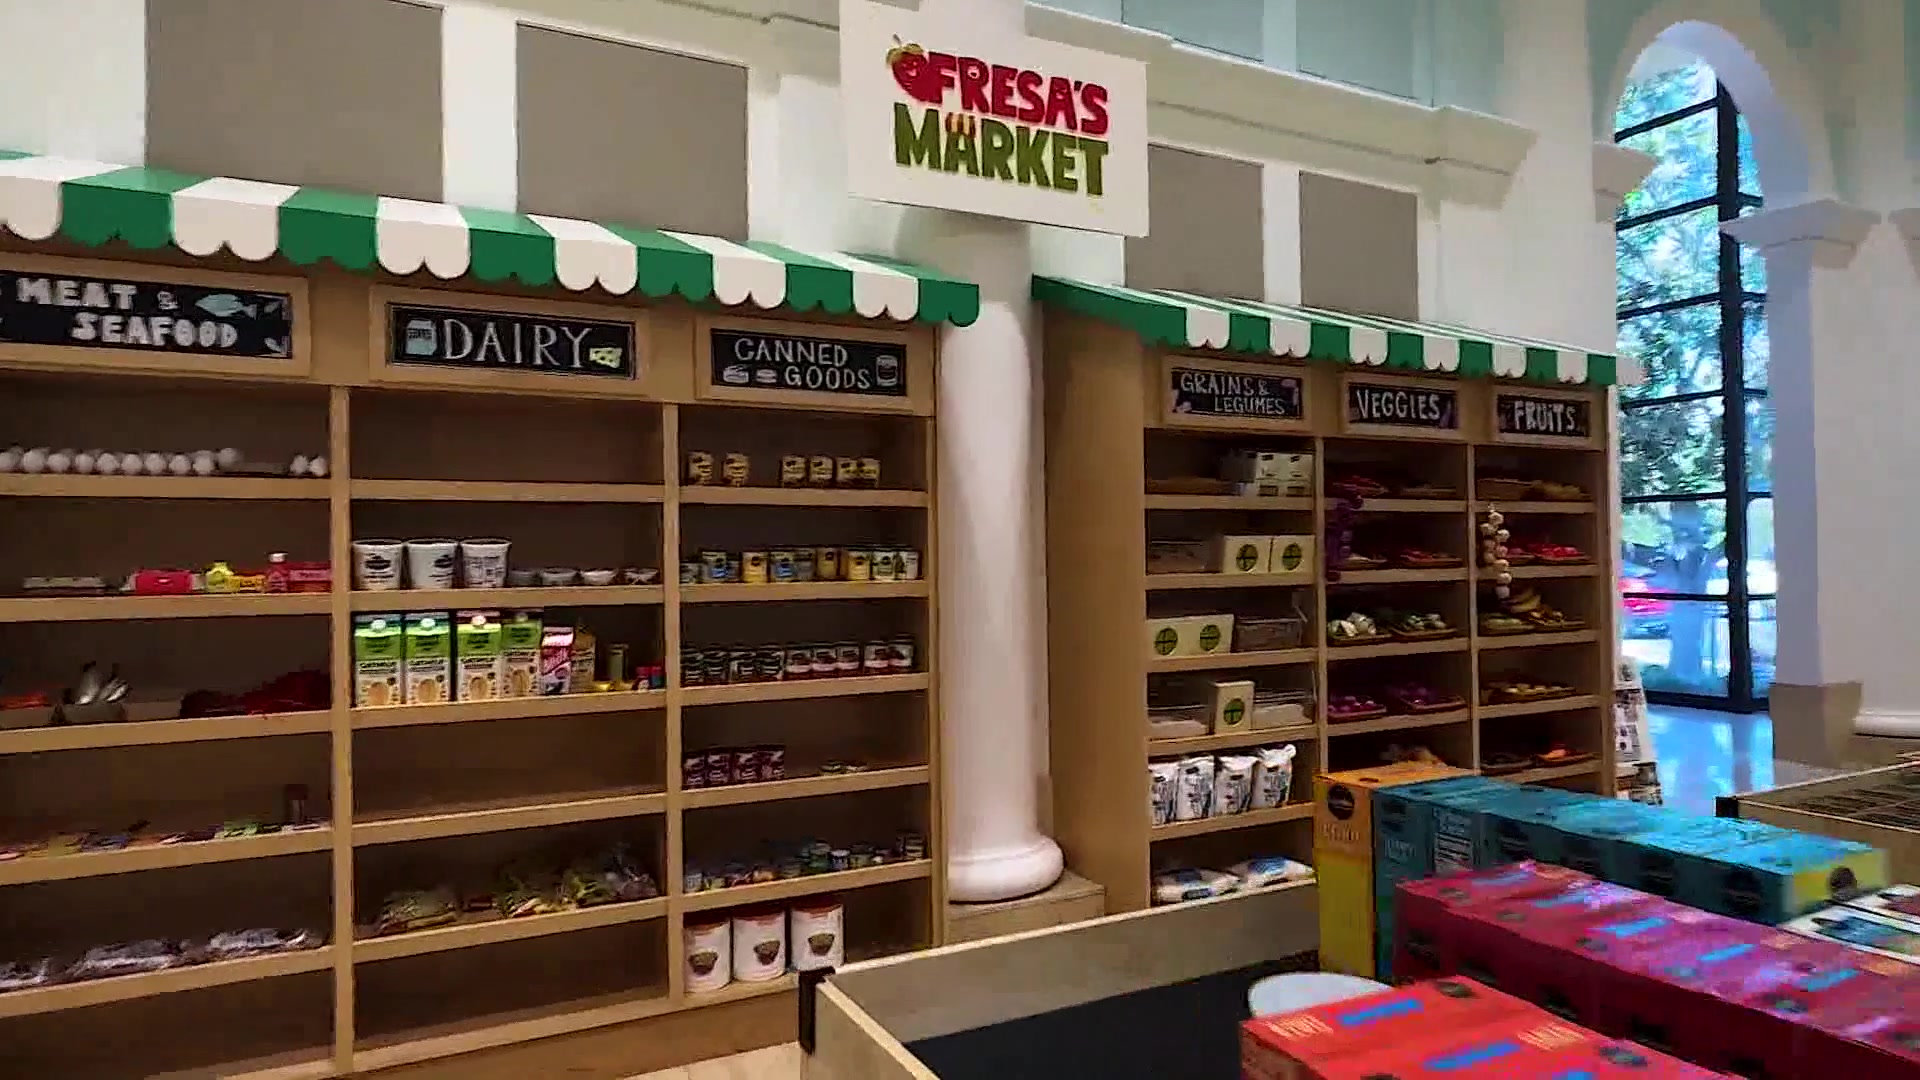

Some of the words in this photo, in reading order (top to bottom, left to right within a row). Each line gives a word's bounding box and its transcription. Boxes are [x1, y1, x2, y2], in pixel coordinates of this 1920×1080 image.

[924, 51, 1108, 134] FRESA'S
[894, 102, 1109, 196] MARKET
[16, 277, 137, 310] MEAT
[157, 290, 179, 310] &
[70, 311, 238, 348] SEAFOOD
[443, 318, 592, 368] DAIRY
[734, 337, 848, 367] CANNED
[783, 365, 871, 389] GOODS
[1180, 372, 1255, 396] GRAINS
[1258, 380, 1270, 396] &
[1214, 396, 1286, 415] LEGUMES
[1356, 388, 1441, 421] VEGGIES
[1514, 400, 1577, 433] FRUITS
